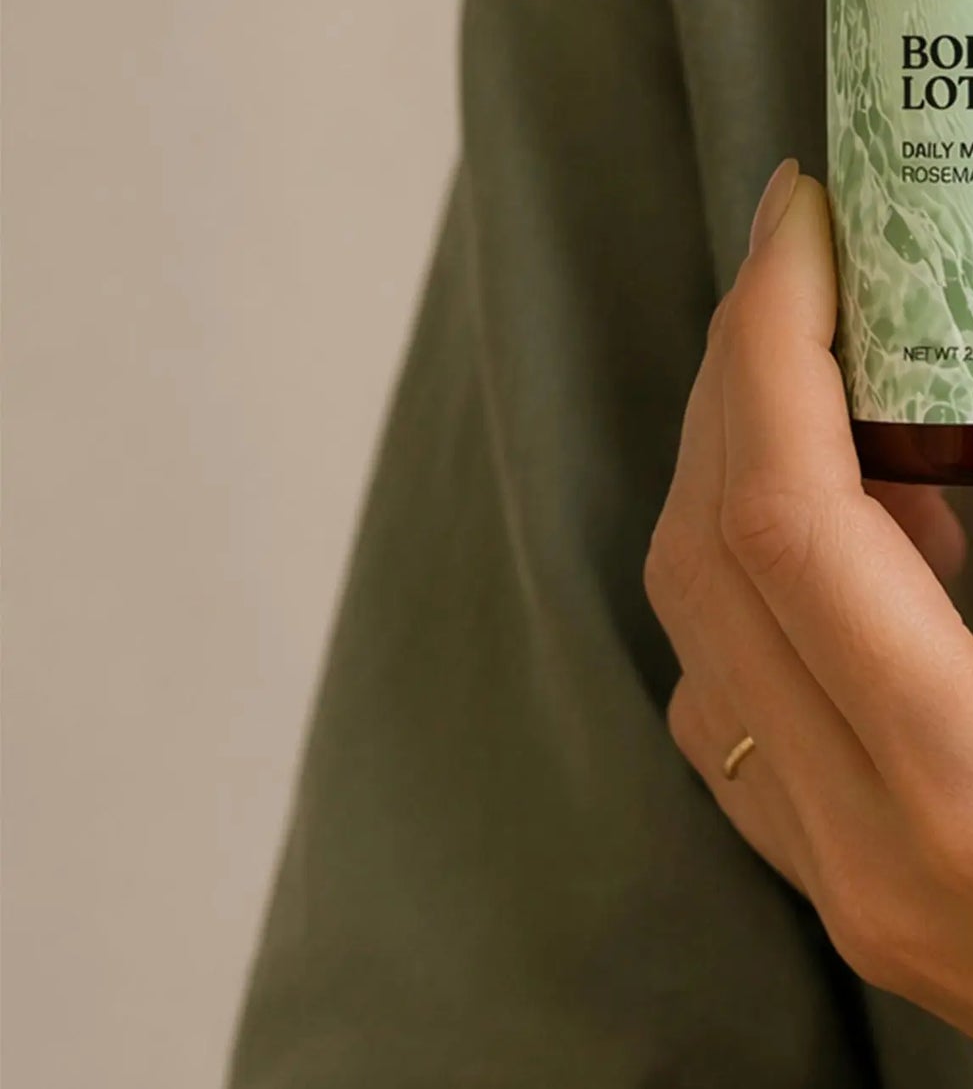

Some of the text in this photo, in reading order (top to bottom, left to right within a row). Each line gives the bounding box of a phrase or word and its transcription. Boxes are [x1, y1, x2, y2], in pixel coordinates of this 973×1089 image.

[902, 141, 954, 159] DAILY
[903, 346, 930, 362] NET
[934, 345, 959, 361] WT
